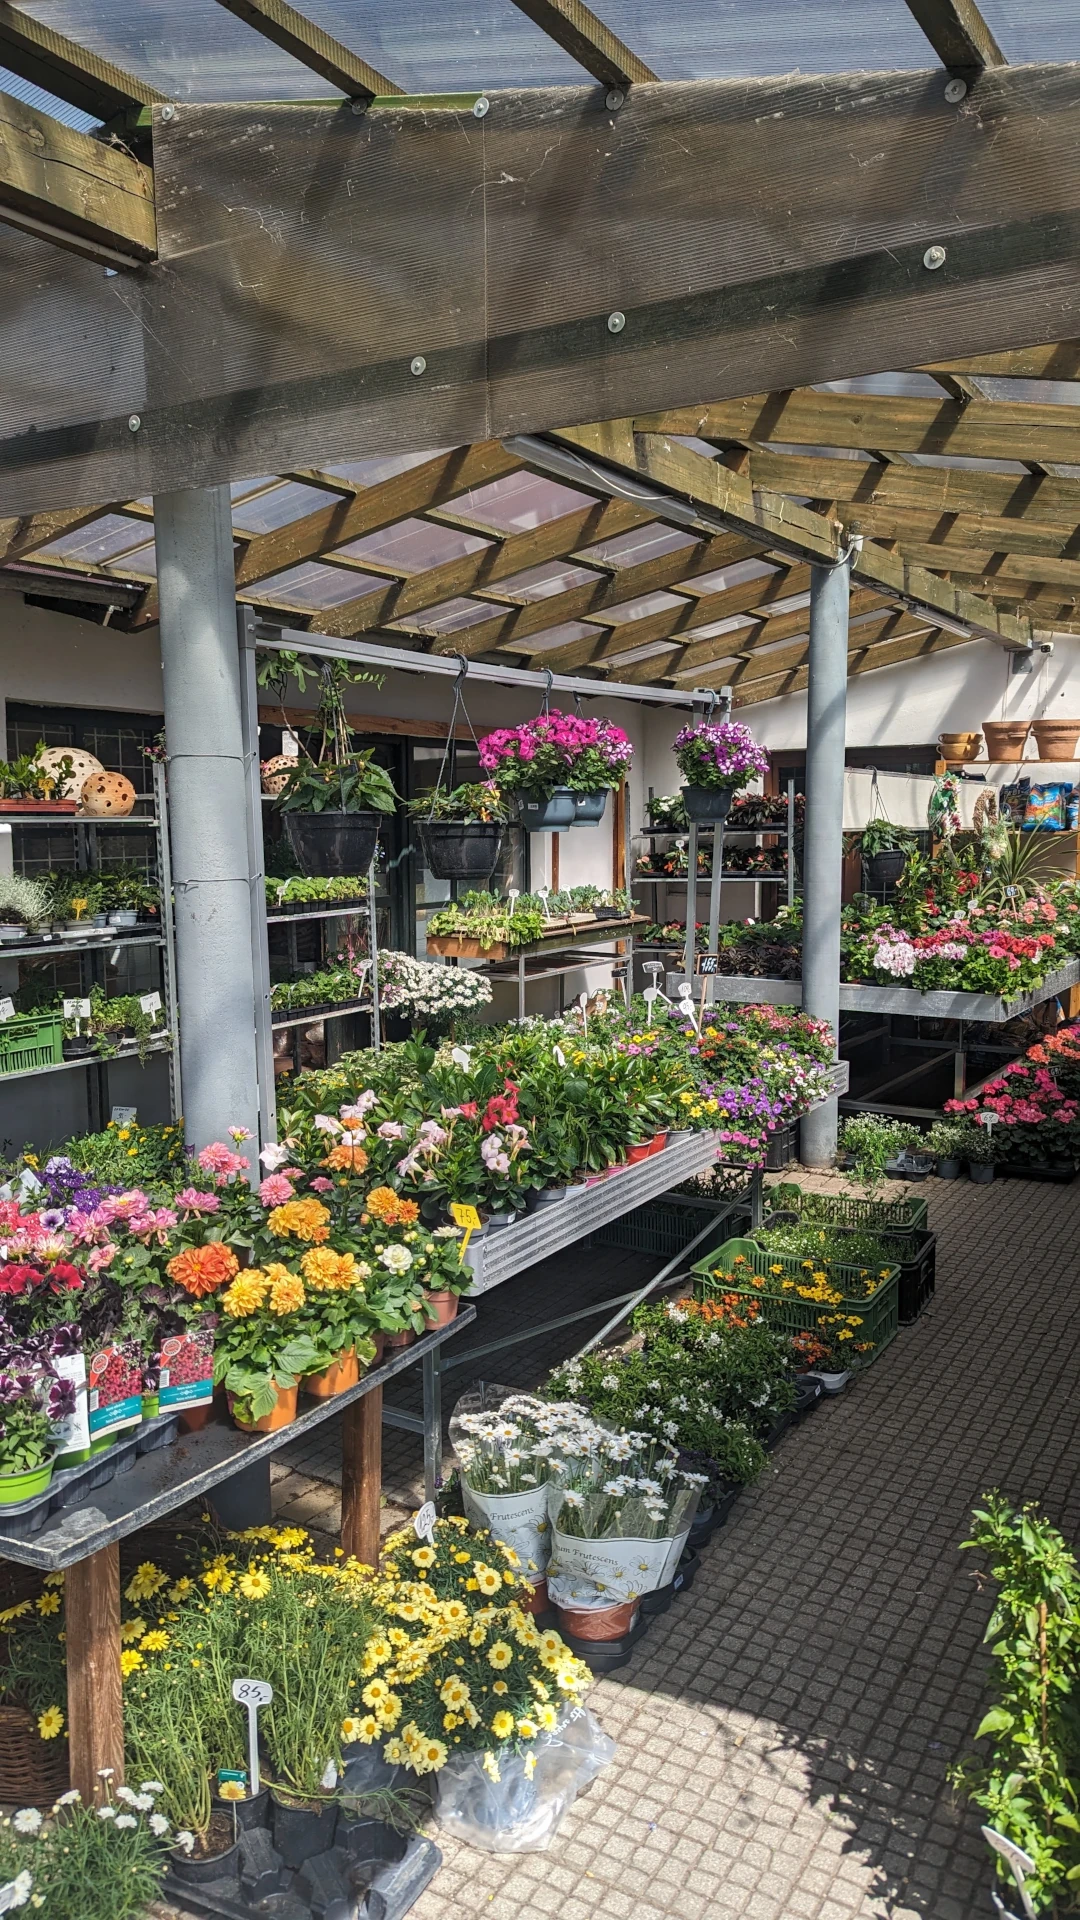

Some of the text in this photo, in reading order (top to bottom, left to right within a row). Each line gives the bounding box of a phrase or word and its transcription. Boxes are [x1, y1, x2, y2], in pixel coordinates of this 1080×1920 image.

[490, 1507, 534, 1521] Frutescens
[572, 1548, 618, 1566] Frutescens
[238, 1684, 269, 1702] 85,-
